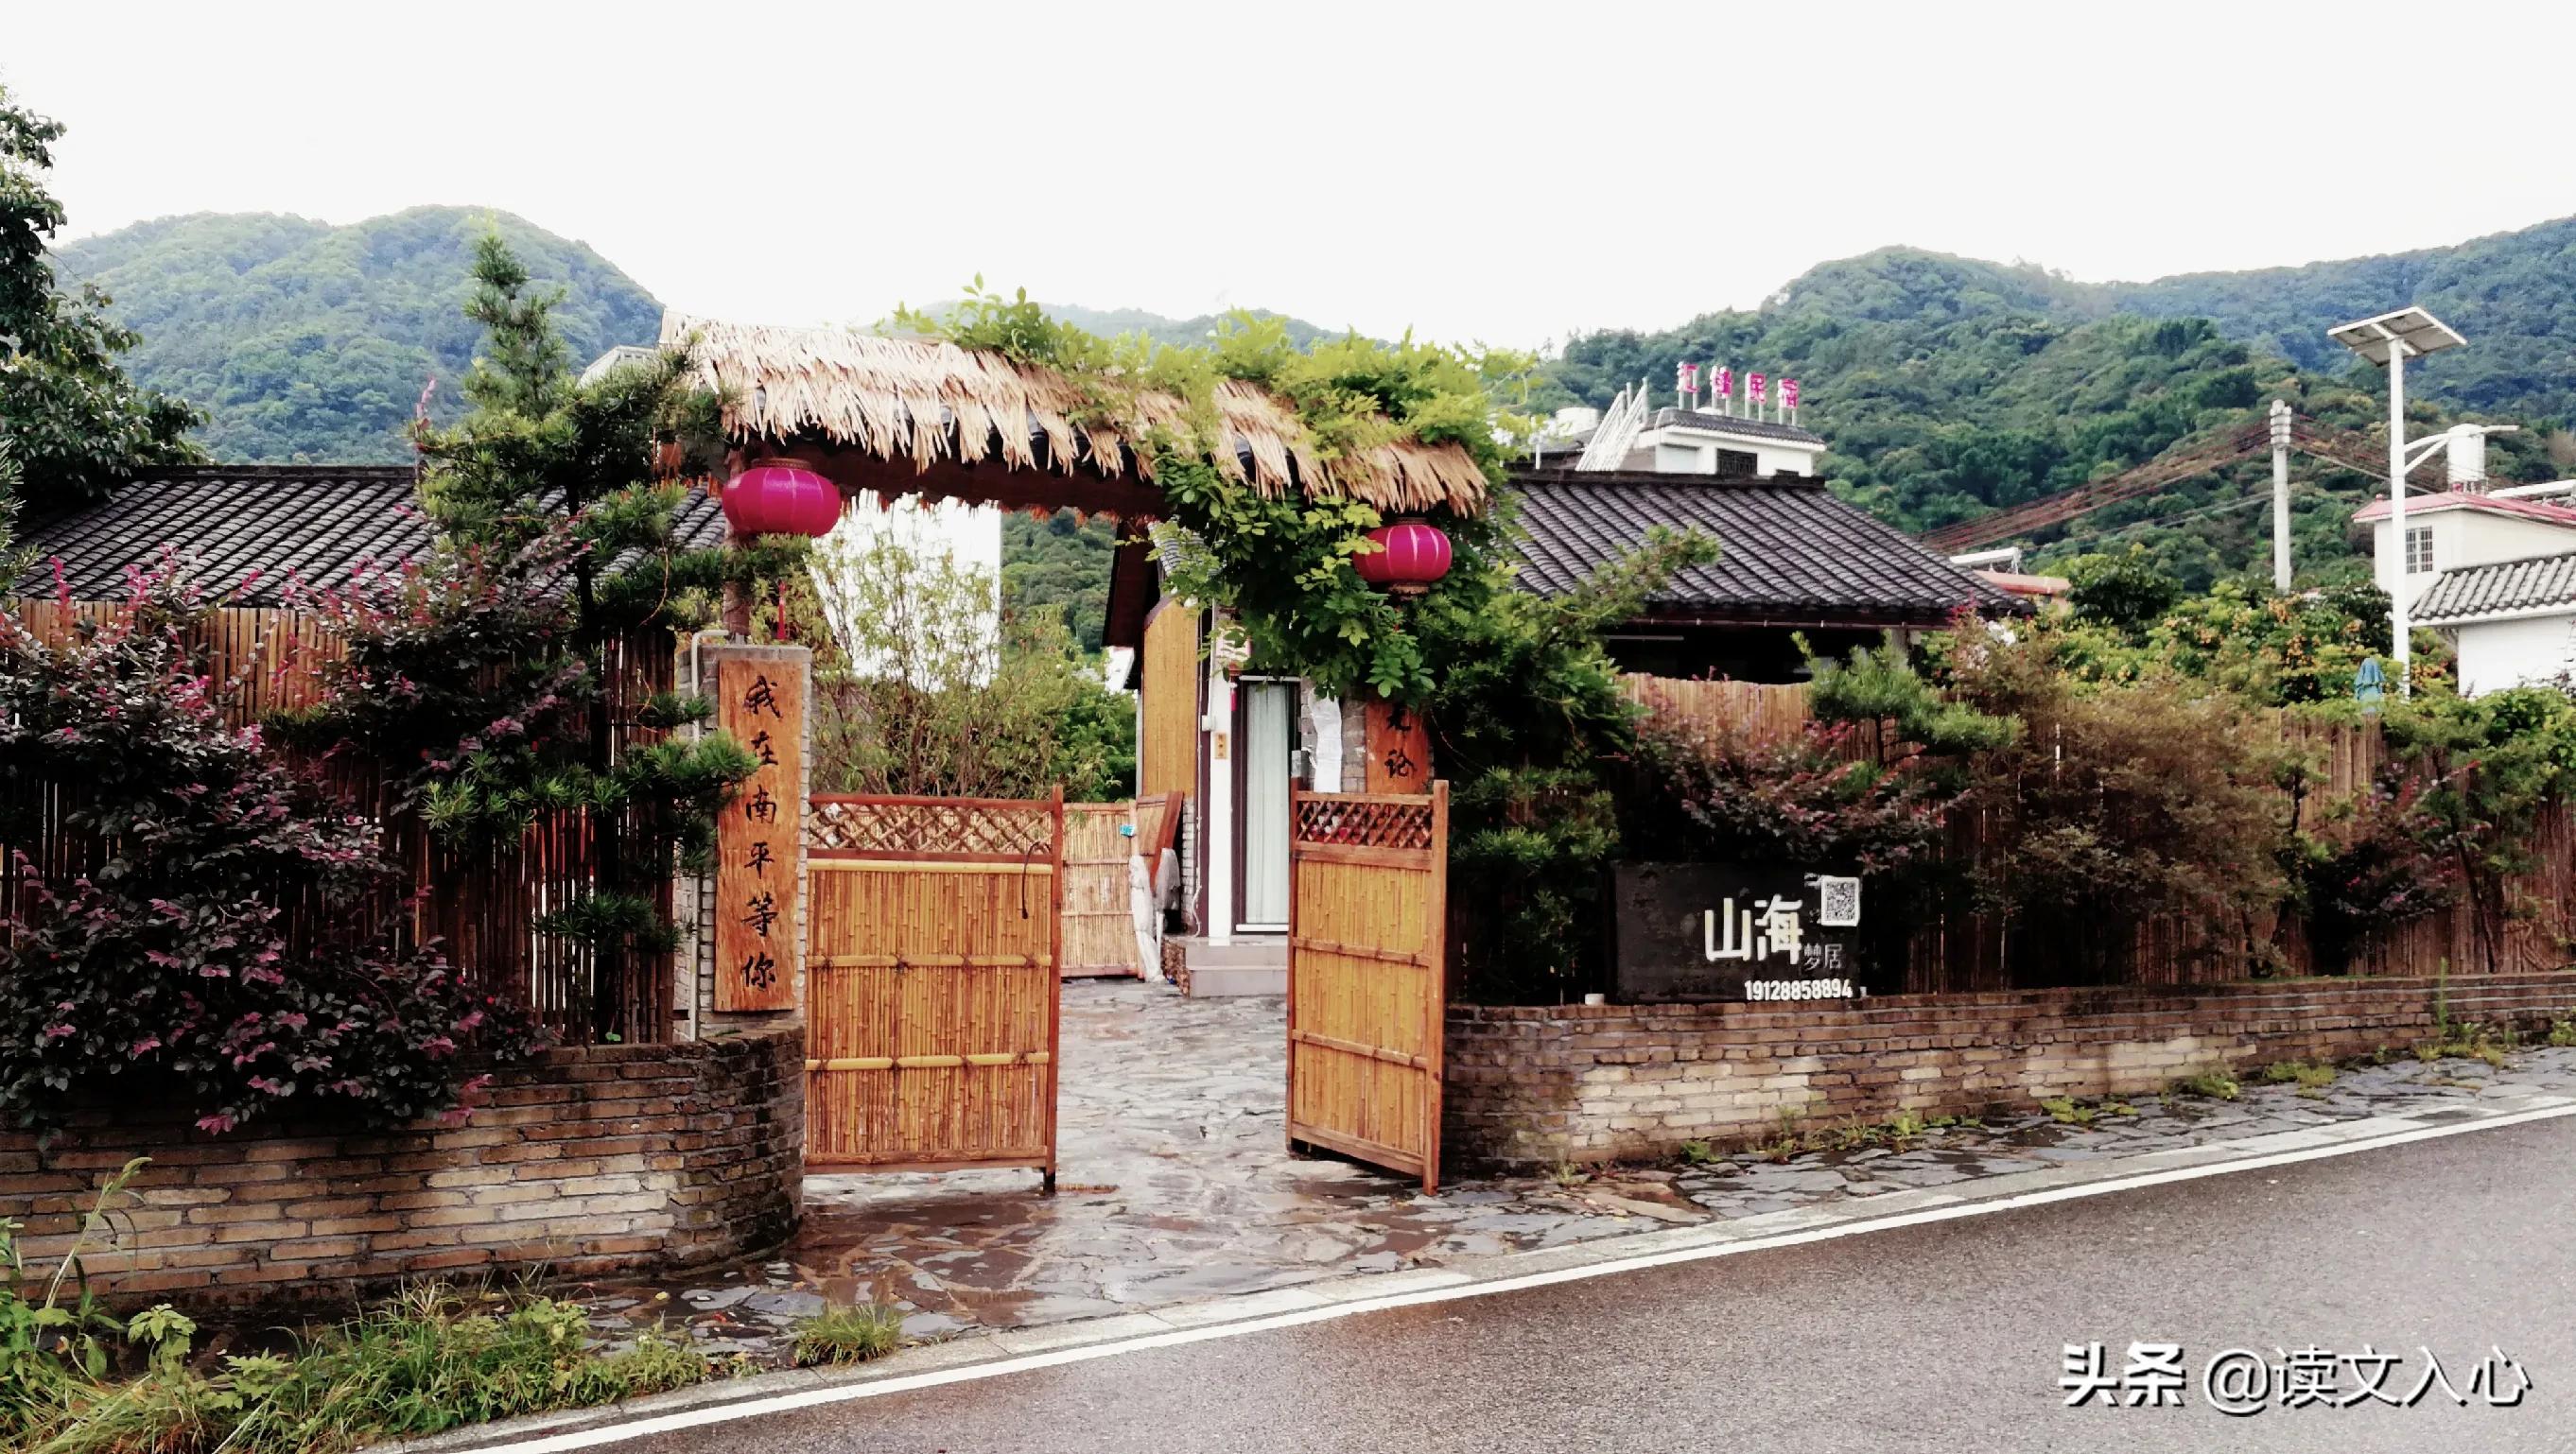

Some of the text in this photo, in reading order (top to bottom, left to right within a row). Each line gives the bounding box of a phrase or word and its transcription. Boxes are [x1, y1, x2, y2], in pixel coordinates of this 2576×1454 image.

[742, 675, 782, 991] 我在南平等你
[1705, 894, 1802, 965] 山海
[1745, 978, 1854, 1001] 19128858894
